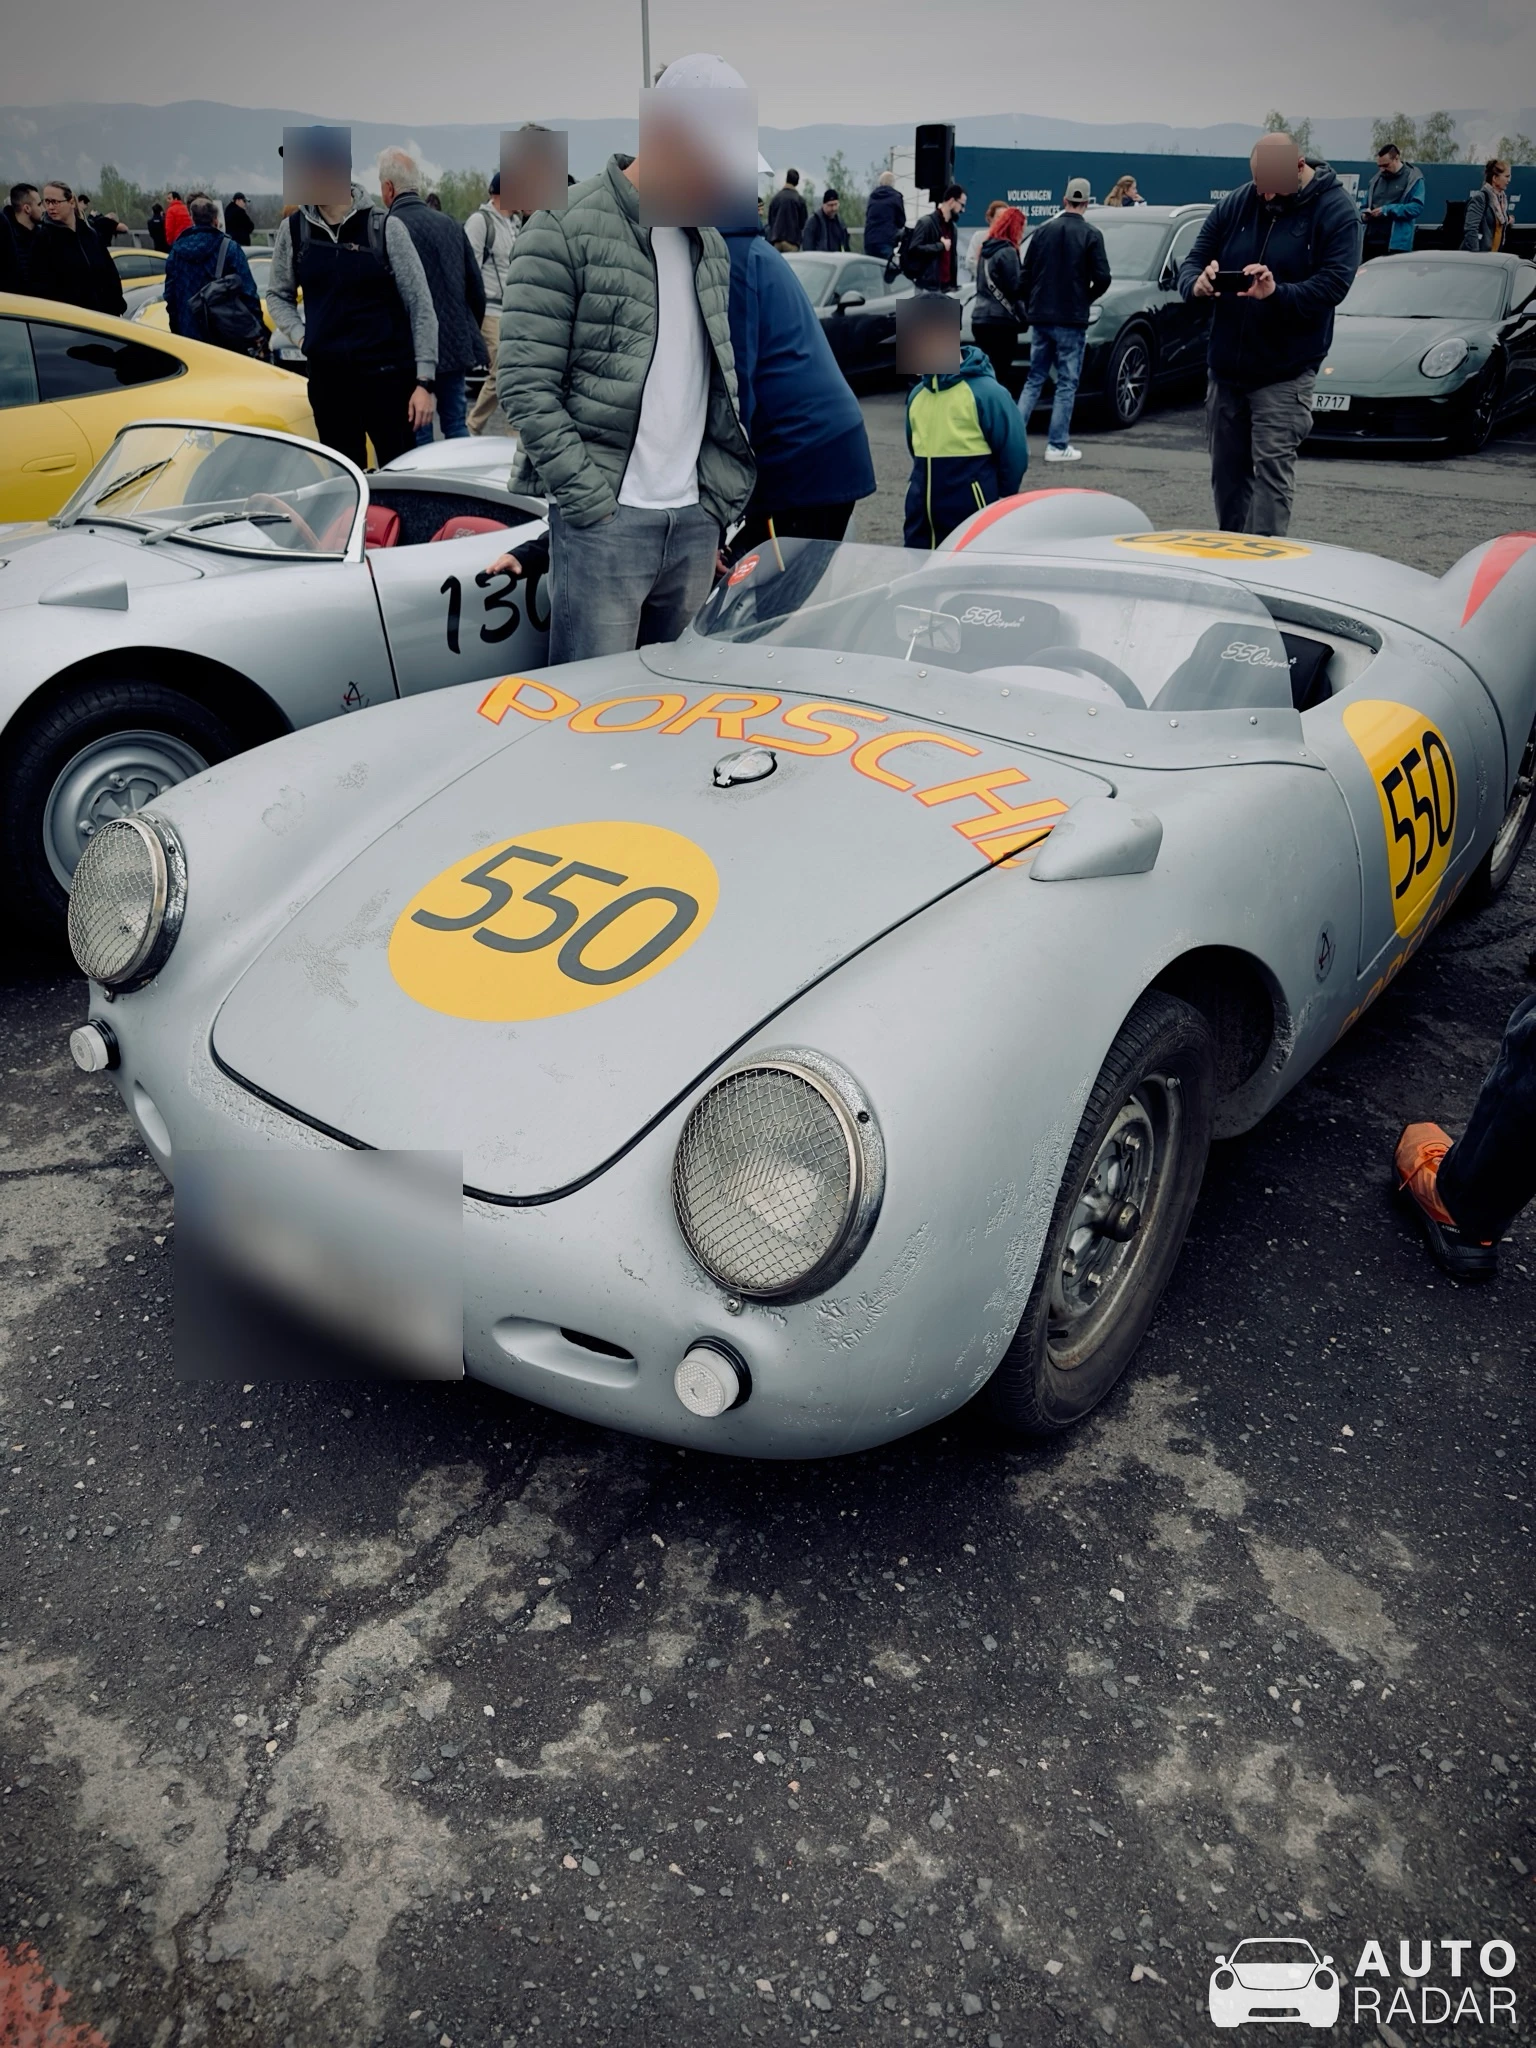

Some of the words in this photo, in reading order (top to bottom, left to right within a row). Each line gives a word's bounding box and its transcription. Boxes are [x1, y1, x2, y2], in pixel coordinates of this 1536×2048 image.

[1007, 190, 1052, 201] VOLKSWAGEN
[1031, 205, 1061, 217] SERVICES
[1316, 395, 1346, 409] R717
[1122, 533, 1304, 558] 550
[960, 606, 1002, 627] 550
[1221, 641, 1270, 666] 550
[1381, 730, 1456, 900] 550
[411, 844, 700, 986] 550
